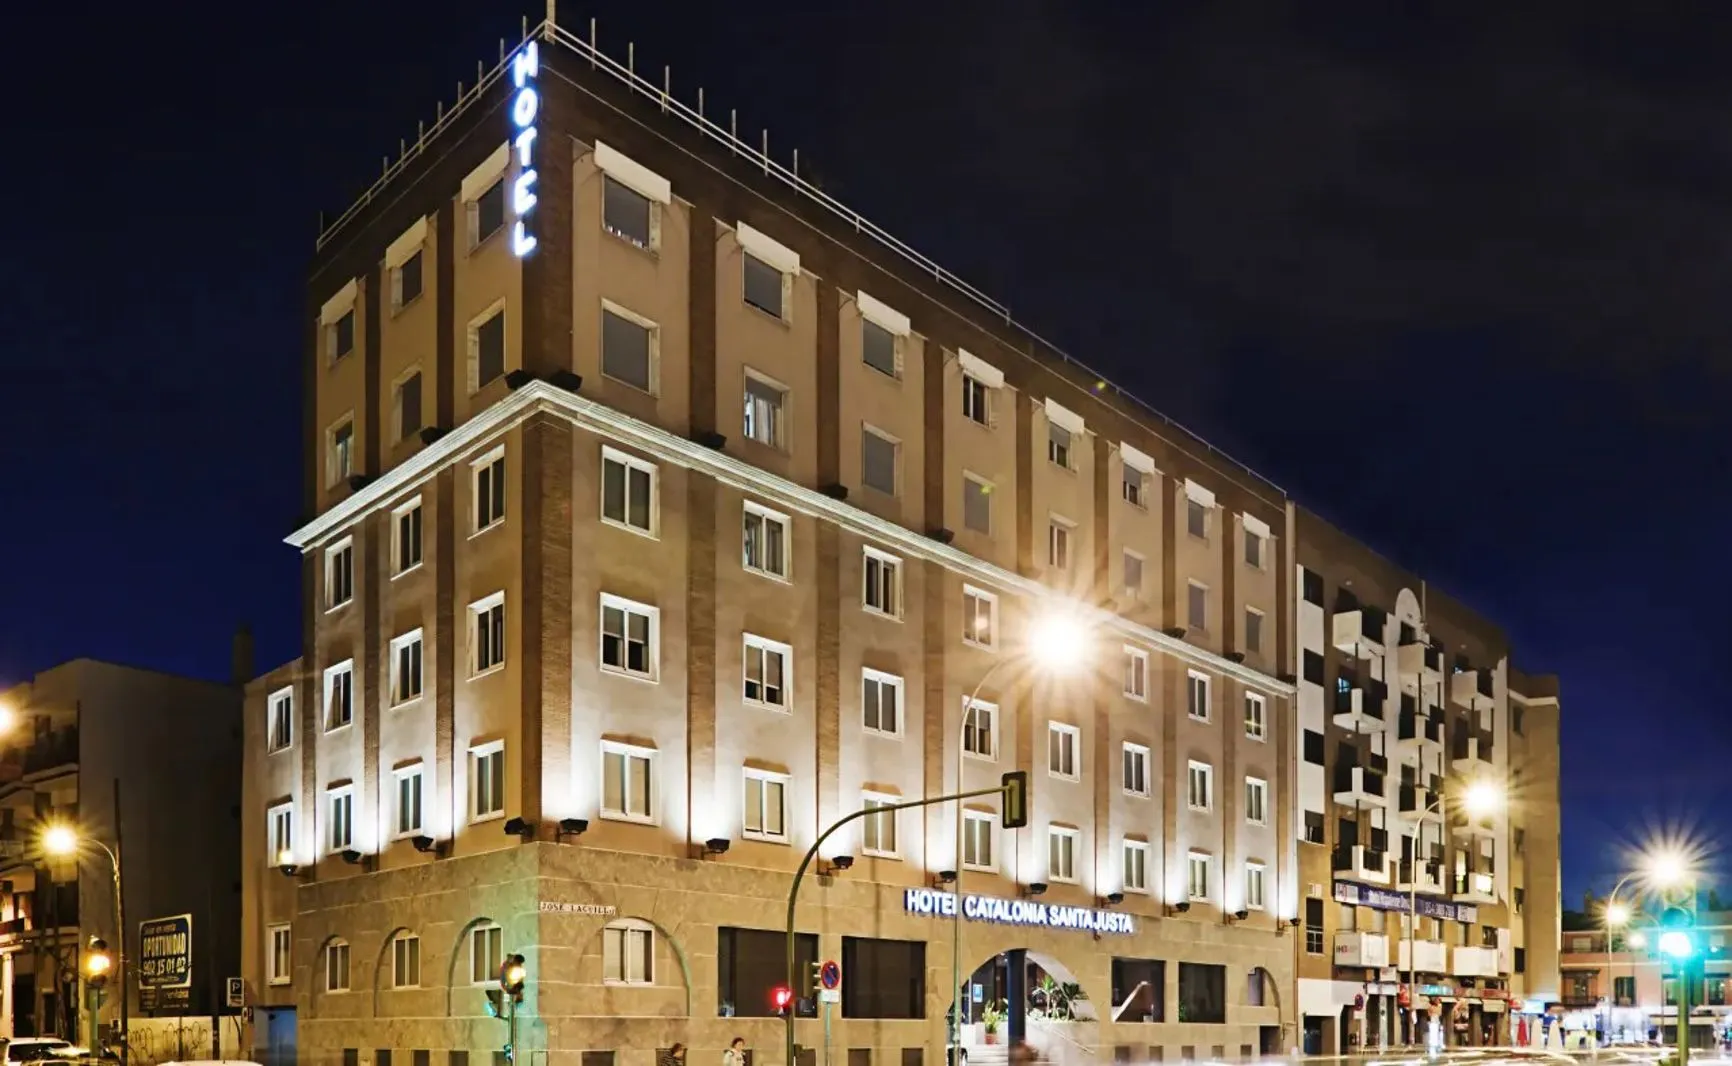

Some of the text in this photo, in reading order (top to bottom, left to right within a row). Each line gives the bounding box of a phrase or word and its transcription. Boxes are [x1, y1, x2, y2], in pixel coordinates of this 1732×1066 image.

[515, 42, 538, 256] HOTEL
[963, 895, 1048, 925] CATALONIA
[1049, 904, 1093, 929] SANTA
[1093, 911, 1134, 933] JUSTA
